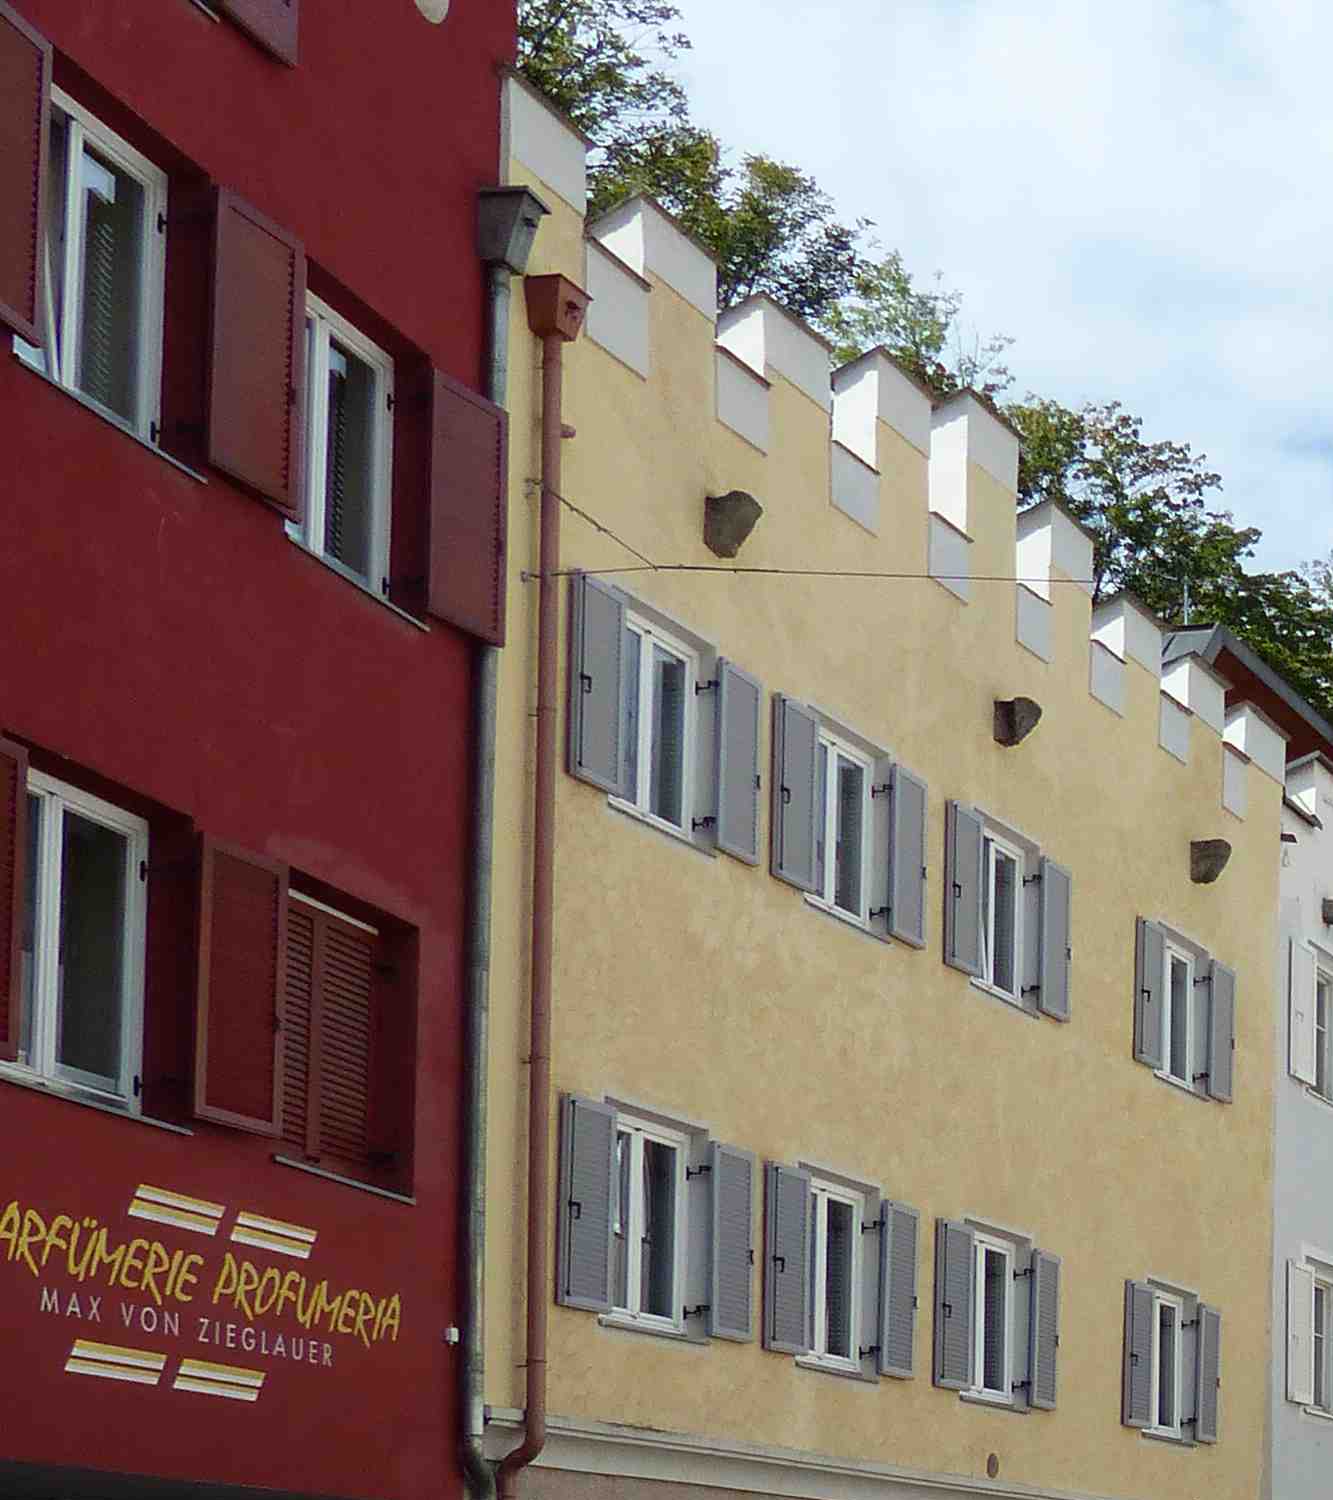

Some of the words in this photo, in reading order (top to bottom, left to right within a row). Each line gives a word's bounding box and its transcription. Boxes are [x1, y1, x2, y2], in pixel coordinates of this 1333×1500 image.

[0, 1200, 204, 1306] ARFÜMERIE
[212, 1251, 400, 1348] PROFUMERIA
[40, 1286, 101, 1322] MAX
[120, 1302, 179, 1336] VON
[197, 1317, 333, 1367] ZIEGLAUER
